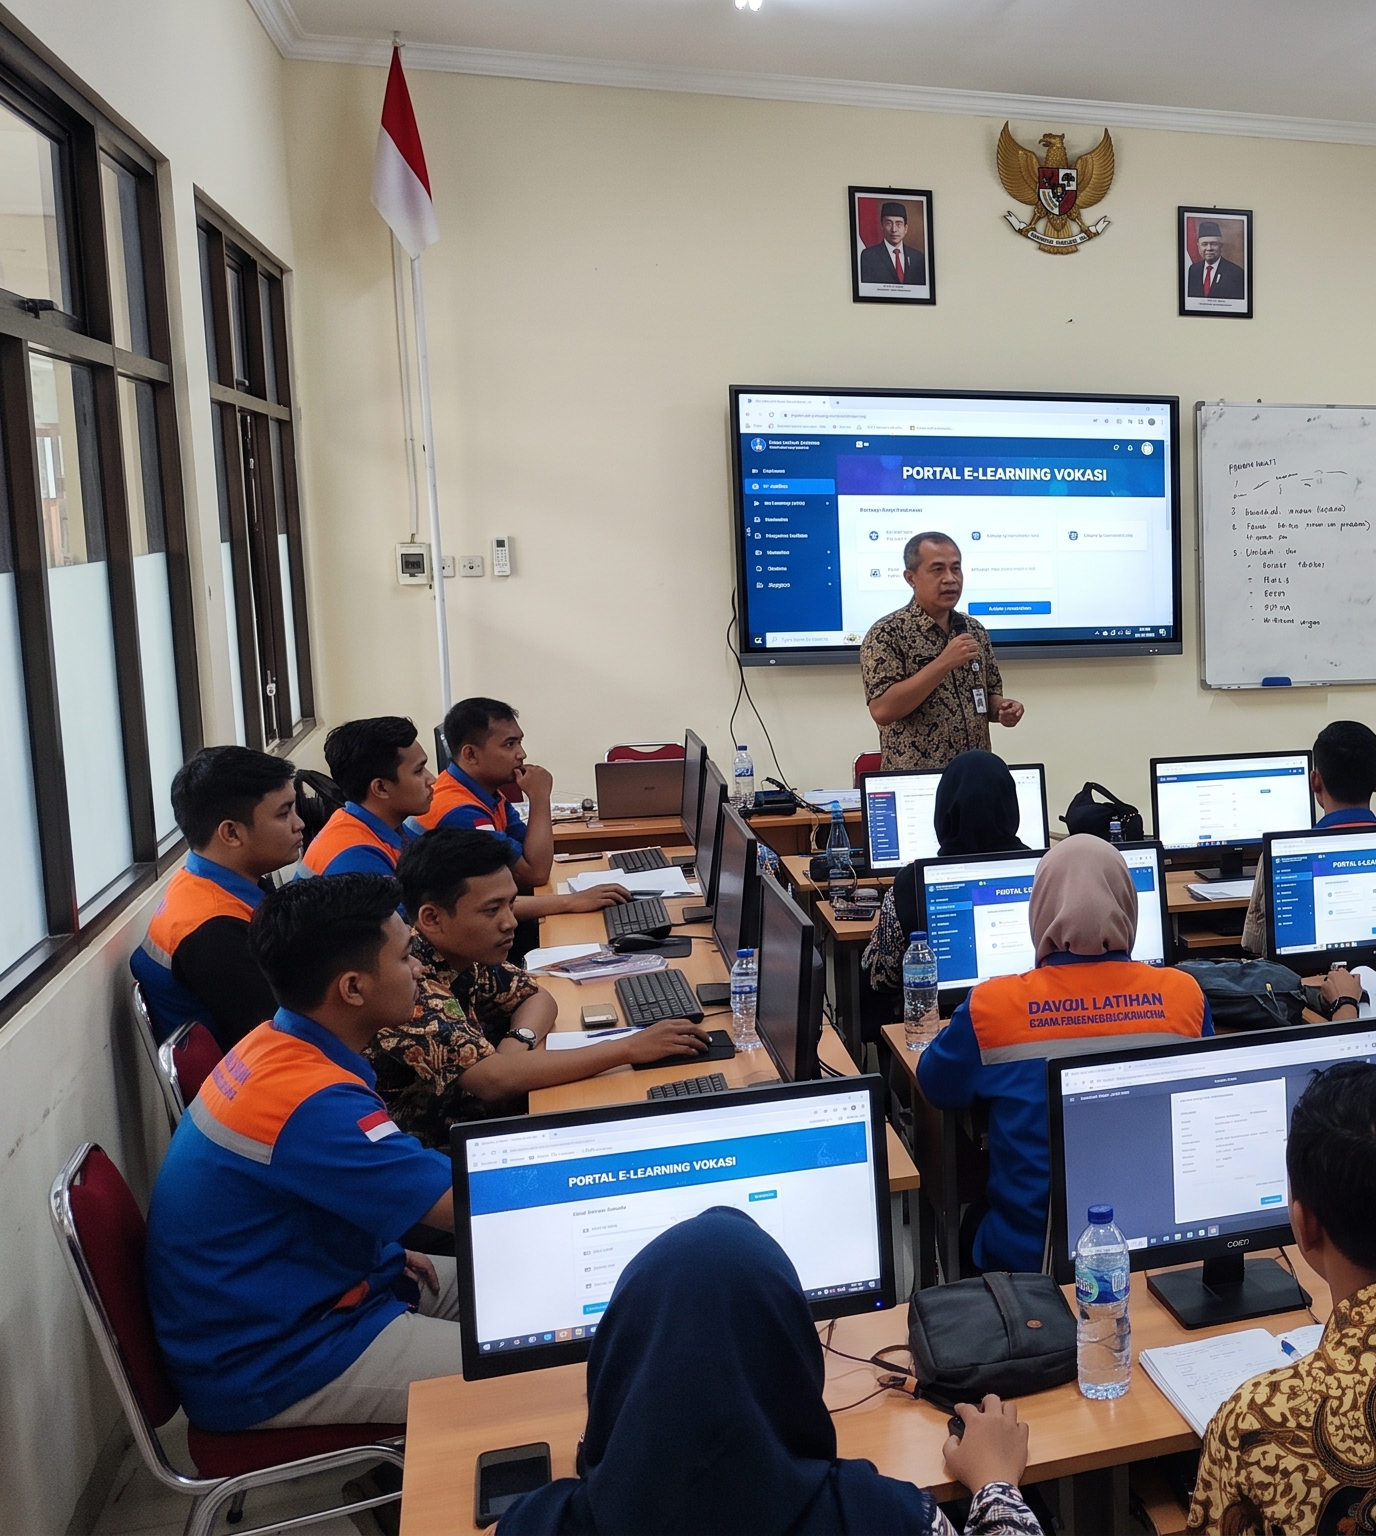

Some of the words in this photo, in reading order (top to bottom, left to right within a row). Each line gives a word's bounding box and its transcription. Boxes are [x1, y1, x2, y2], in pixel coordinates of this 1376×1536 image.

[902, 466, 962, 480] PORTAL
[964, 467, 1052, 481] E-LEARNING
[1053, 468, 1107, 482] VOKASI
[1092, 992, 1164, 1011] LATIHAN
[568, 1173, 617, 1188] PORTAL
[618, 1162, 691, 1181] E-LEARNING
[692, 1156, 737, 1171] VOKASI
